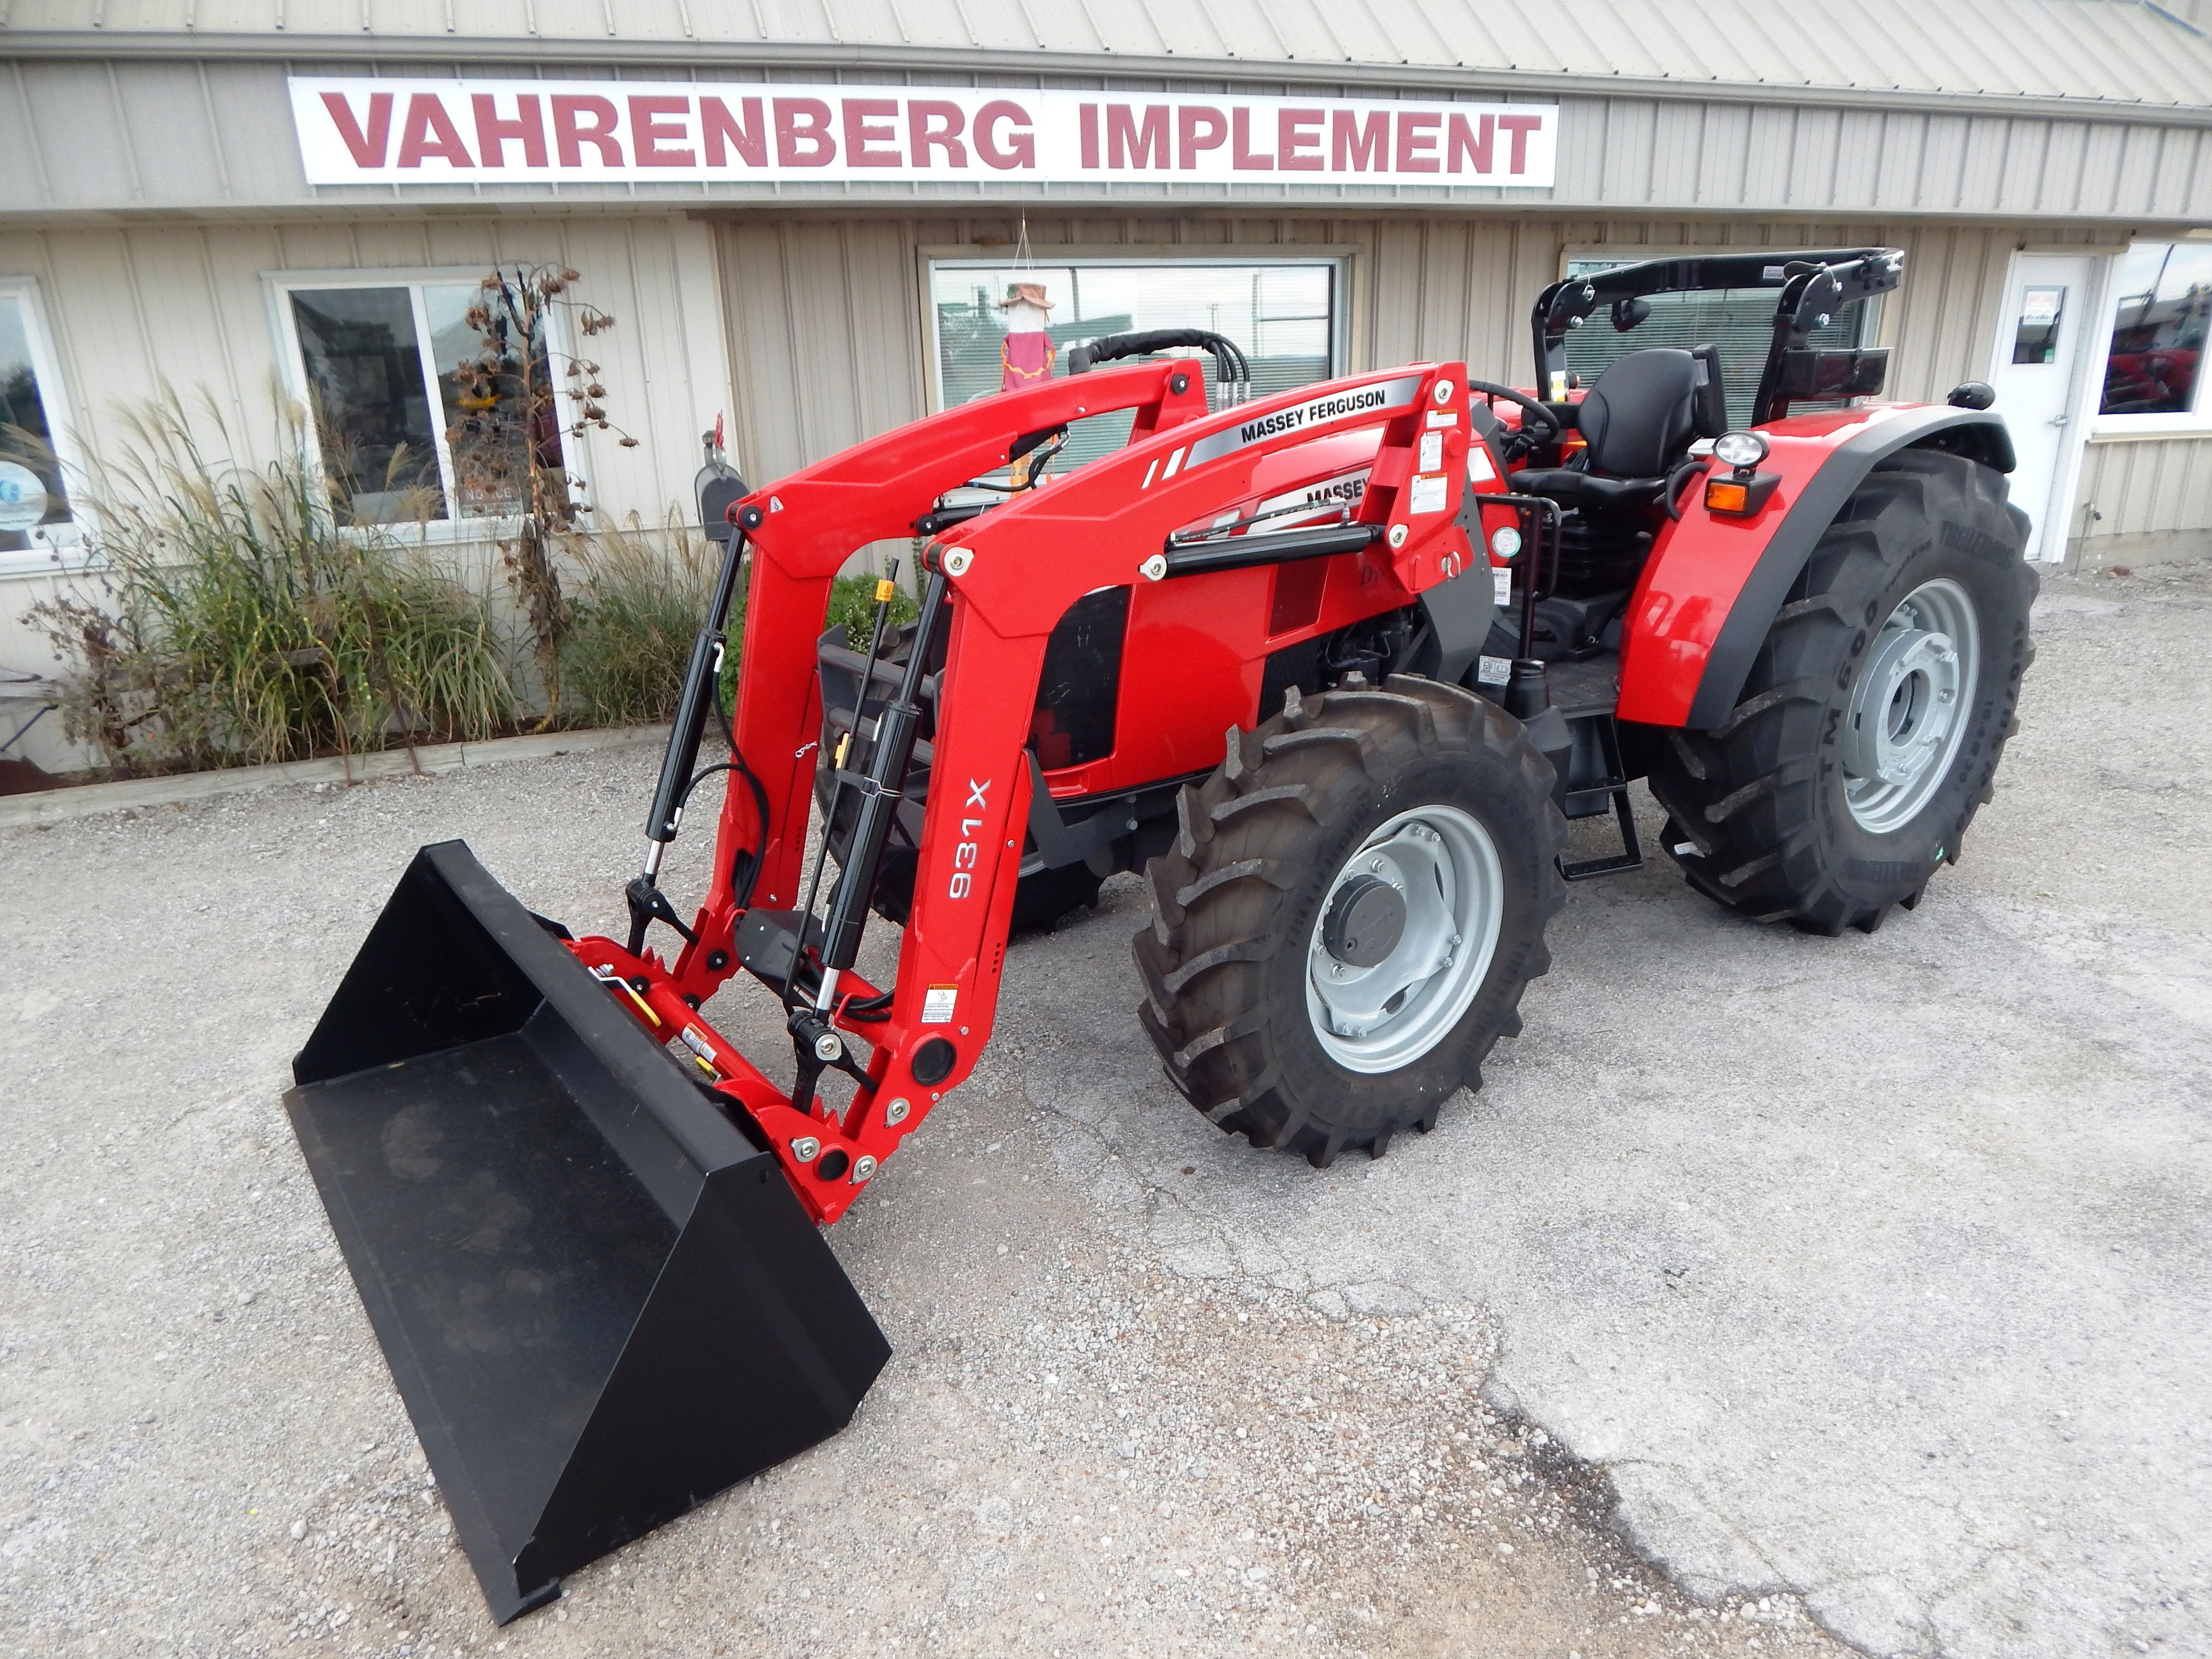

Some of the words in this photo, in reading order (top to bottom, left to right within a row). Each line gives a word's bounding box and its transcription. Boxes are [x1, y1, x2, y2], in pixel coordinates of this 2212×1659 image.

[320, 91, 1036, 170] VAHRENBERG
[1080, 103, 1541, 175] IMPLEMENT
[1241, 409, 1304, 438] MASSEY
[1309, 389, 1385, 421] FERGUSON
[965, 777, 991, 811] X
[949, 818, 983, 899] 931
